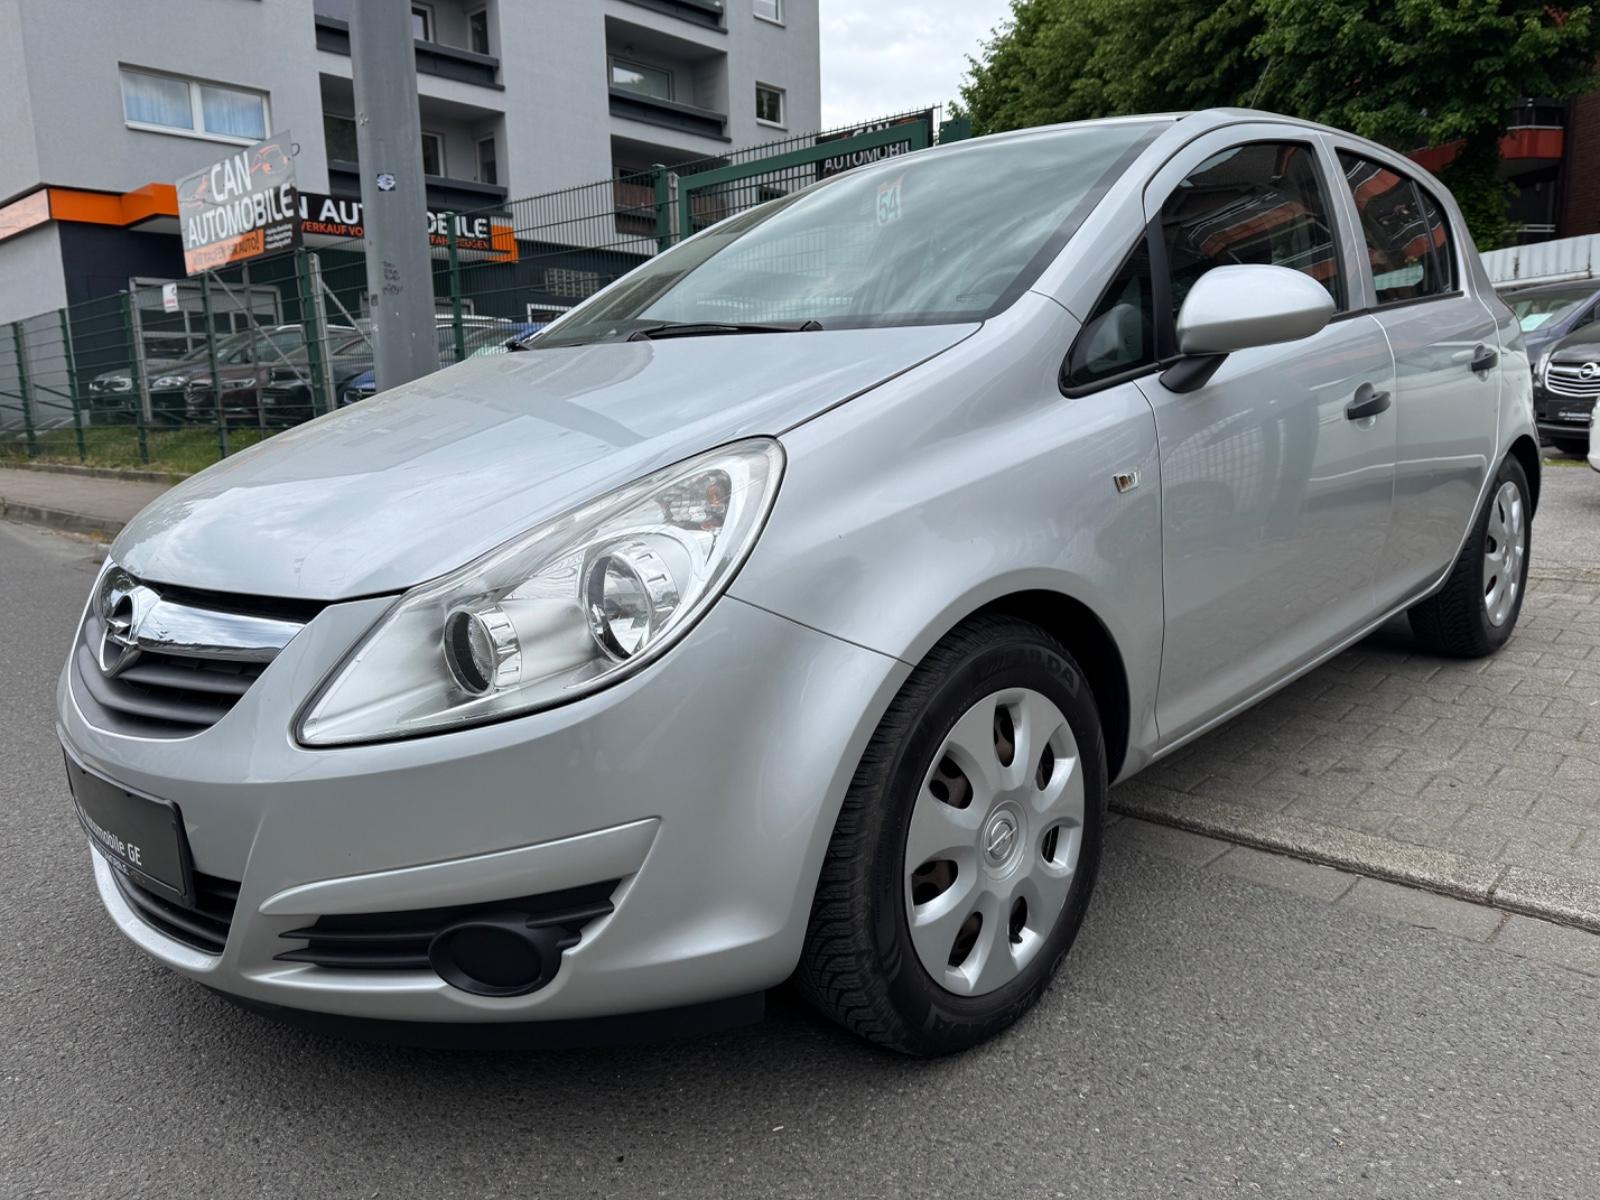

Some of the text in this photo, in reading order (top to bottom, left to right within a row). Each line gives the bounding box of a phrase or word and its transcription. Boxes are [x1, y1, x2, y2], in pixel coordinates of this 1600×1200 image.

[823, 141, 911, 171] AUTOMOBIL
[211, 151, 252, 202] CAN
[188, 182, 295, 248] AUTOMOBILE
[127, 843, 143, 866] GE
